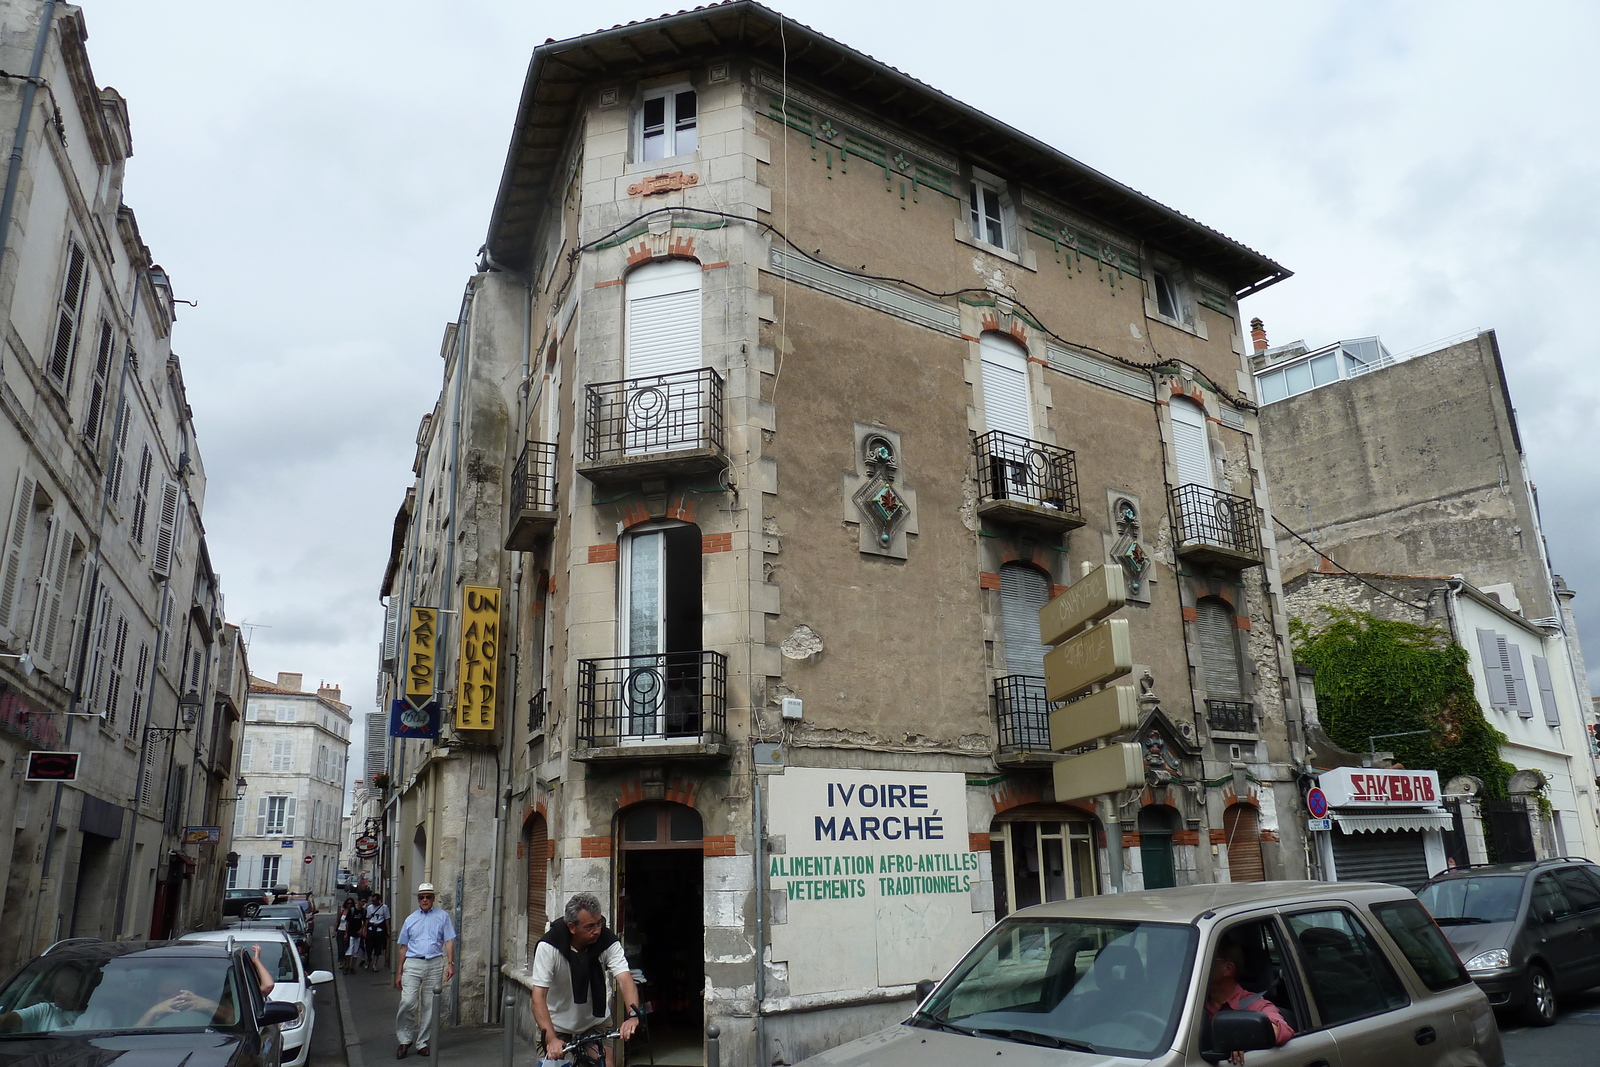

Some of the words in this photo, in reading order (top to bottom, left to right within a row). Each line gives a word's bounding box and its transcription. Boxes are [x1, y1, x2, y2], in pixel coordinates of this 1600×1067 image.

[468, 591, 497, 613] UN
[412, 610, 432, 647] BAR
[410, 653, 431, 690] POP
[463, 620, 479, 723] AUTRE
[480, 621, 495, 723] MONDE
[827, 783, 928, 808] IVOIRE
[814, 809, 944, 841] MARCHÉ
[770, 855, 874, 877] ALIMENTATION
[879, 853, 978, 875] AFRO-ANTILLES
[787, 879, 865, 900] VETEMENTS
[878, 875, 971, 896] TRADITIONNELS
